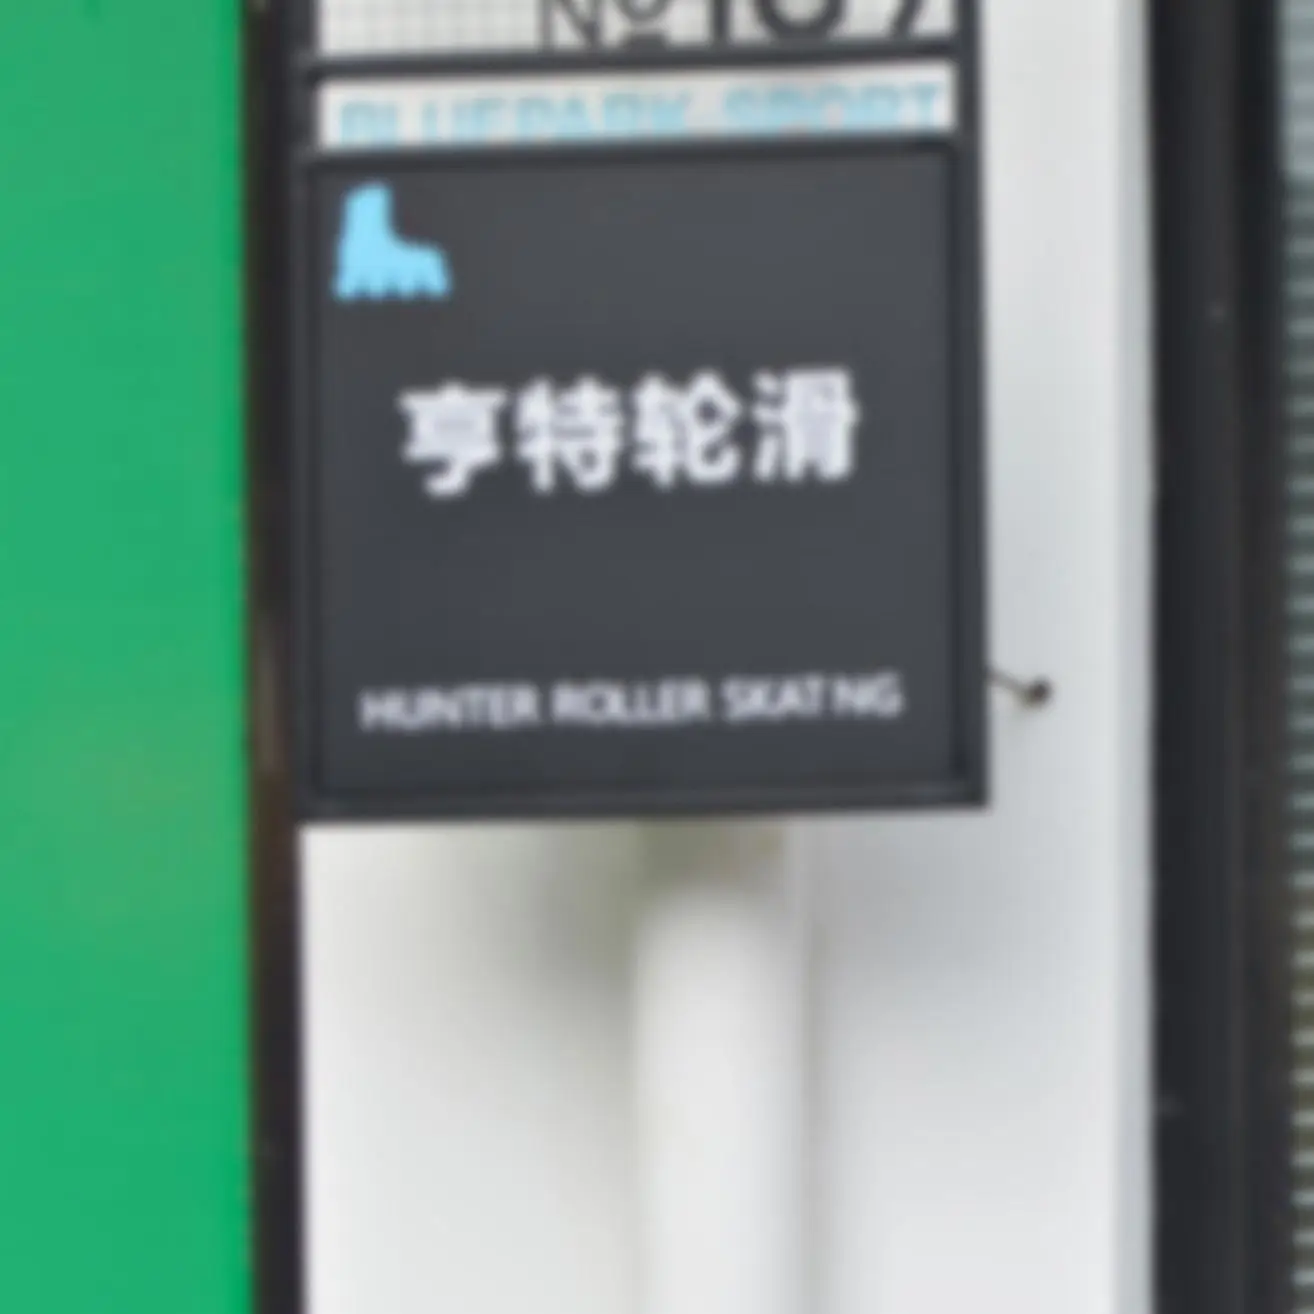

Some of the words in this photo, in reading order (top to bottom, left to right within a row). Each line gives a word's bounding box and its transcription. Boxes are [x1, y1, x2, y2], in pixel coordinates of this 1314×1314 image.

[398, 366, 858, 498] 亨特轮滑
[357, 680, 540, 732] HUNTER
[551, 676, 711, 728] ROLLER
